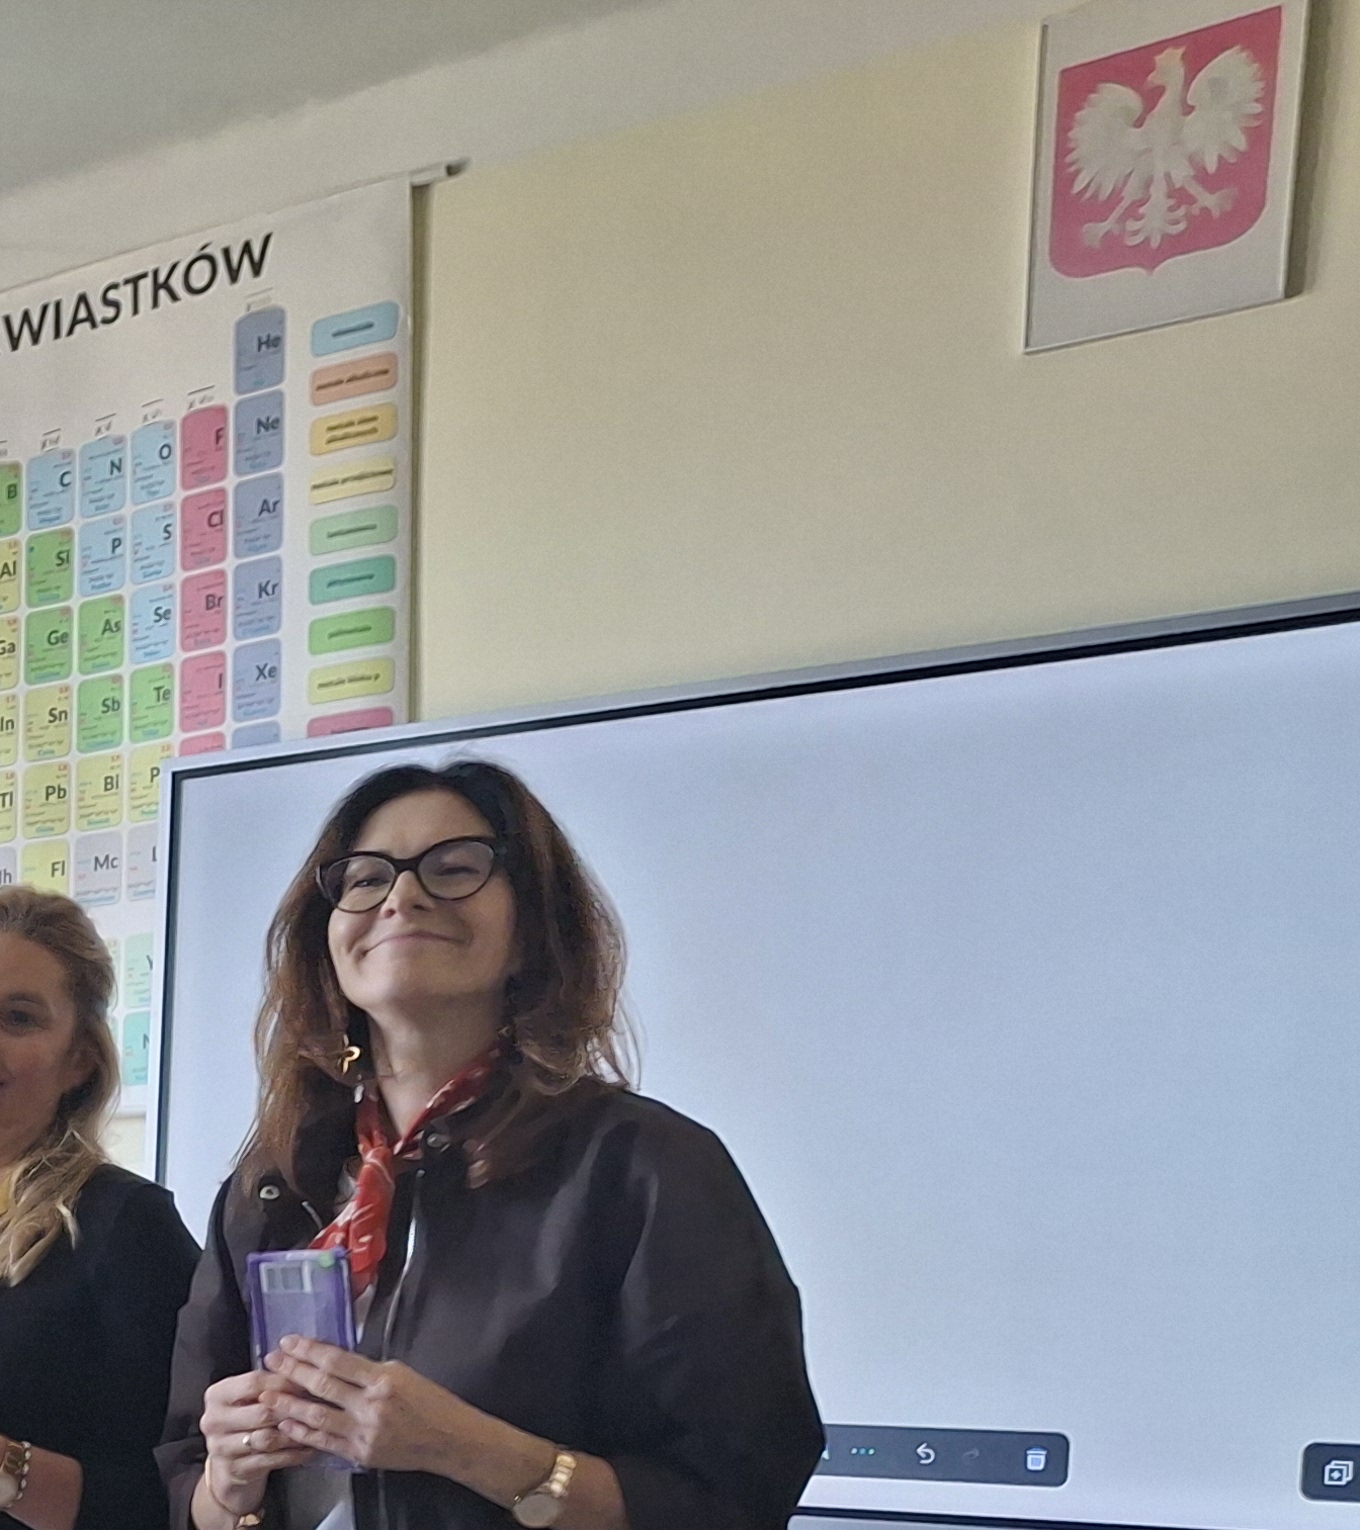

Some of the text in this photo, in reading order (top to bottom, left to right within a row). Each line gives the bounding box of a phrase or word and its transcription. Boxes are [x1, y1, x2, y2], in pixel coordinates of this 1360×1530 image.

[256, 415, 280, 434] Ne
[215, 427, 224, 445] F
[158, 443, 172, 460] O
[110, 458, 122, 475] N
[59, 471, 71, 487] C
[7, 484, 17, 499] B
[258, 498, 279, 517] Ar
[207, 510, 224, 528] Cl
[163, 524, 172, 540] S
[112, 538, 122, 554] P
[0, 561, 17, 579] Al
[258, 579, 278, 598] Kr
[205, 593, 224, 610] Br
[153, 606, 171, 623] Se
[101, 618, 121, 635] As
[47, 630, 69, 646] Ge
[256, 663, 277, 681] Xe
[153, 685, 171, 702] Te
[101, 698, 120, 714] Sb
[0, 716, 14, 732] In
[48, 707, 68, 724] Sn
[45, 784, 67, 801] Pb
[94, 854, 119, 871] Mc
